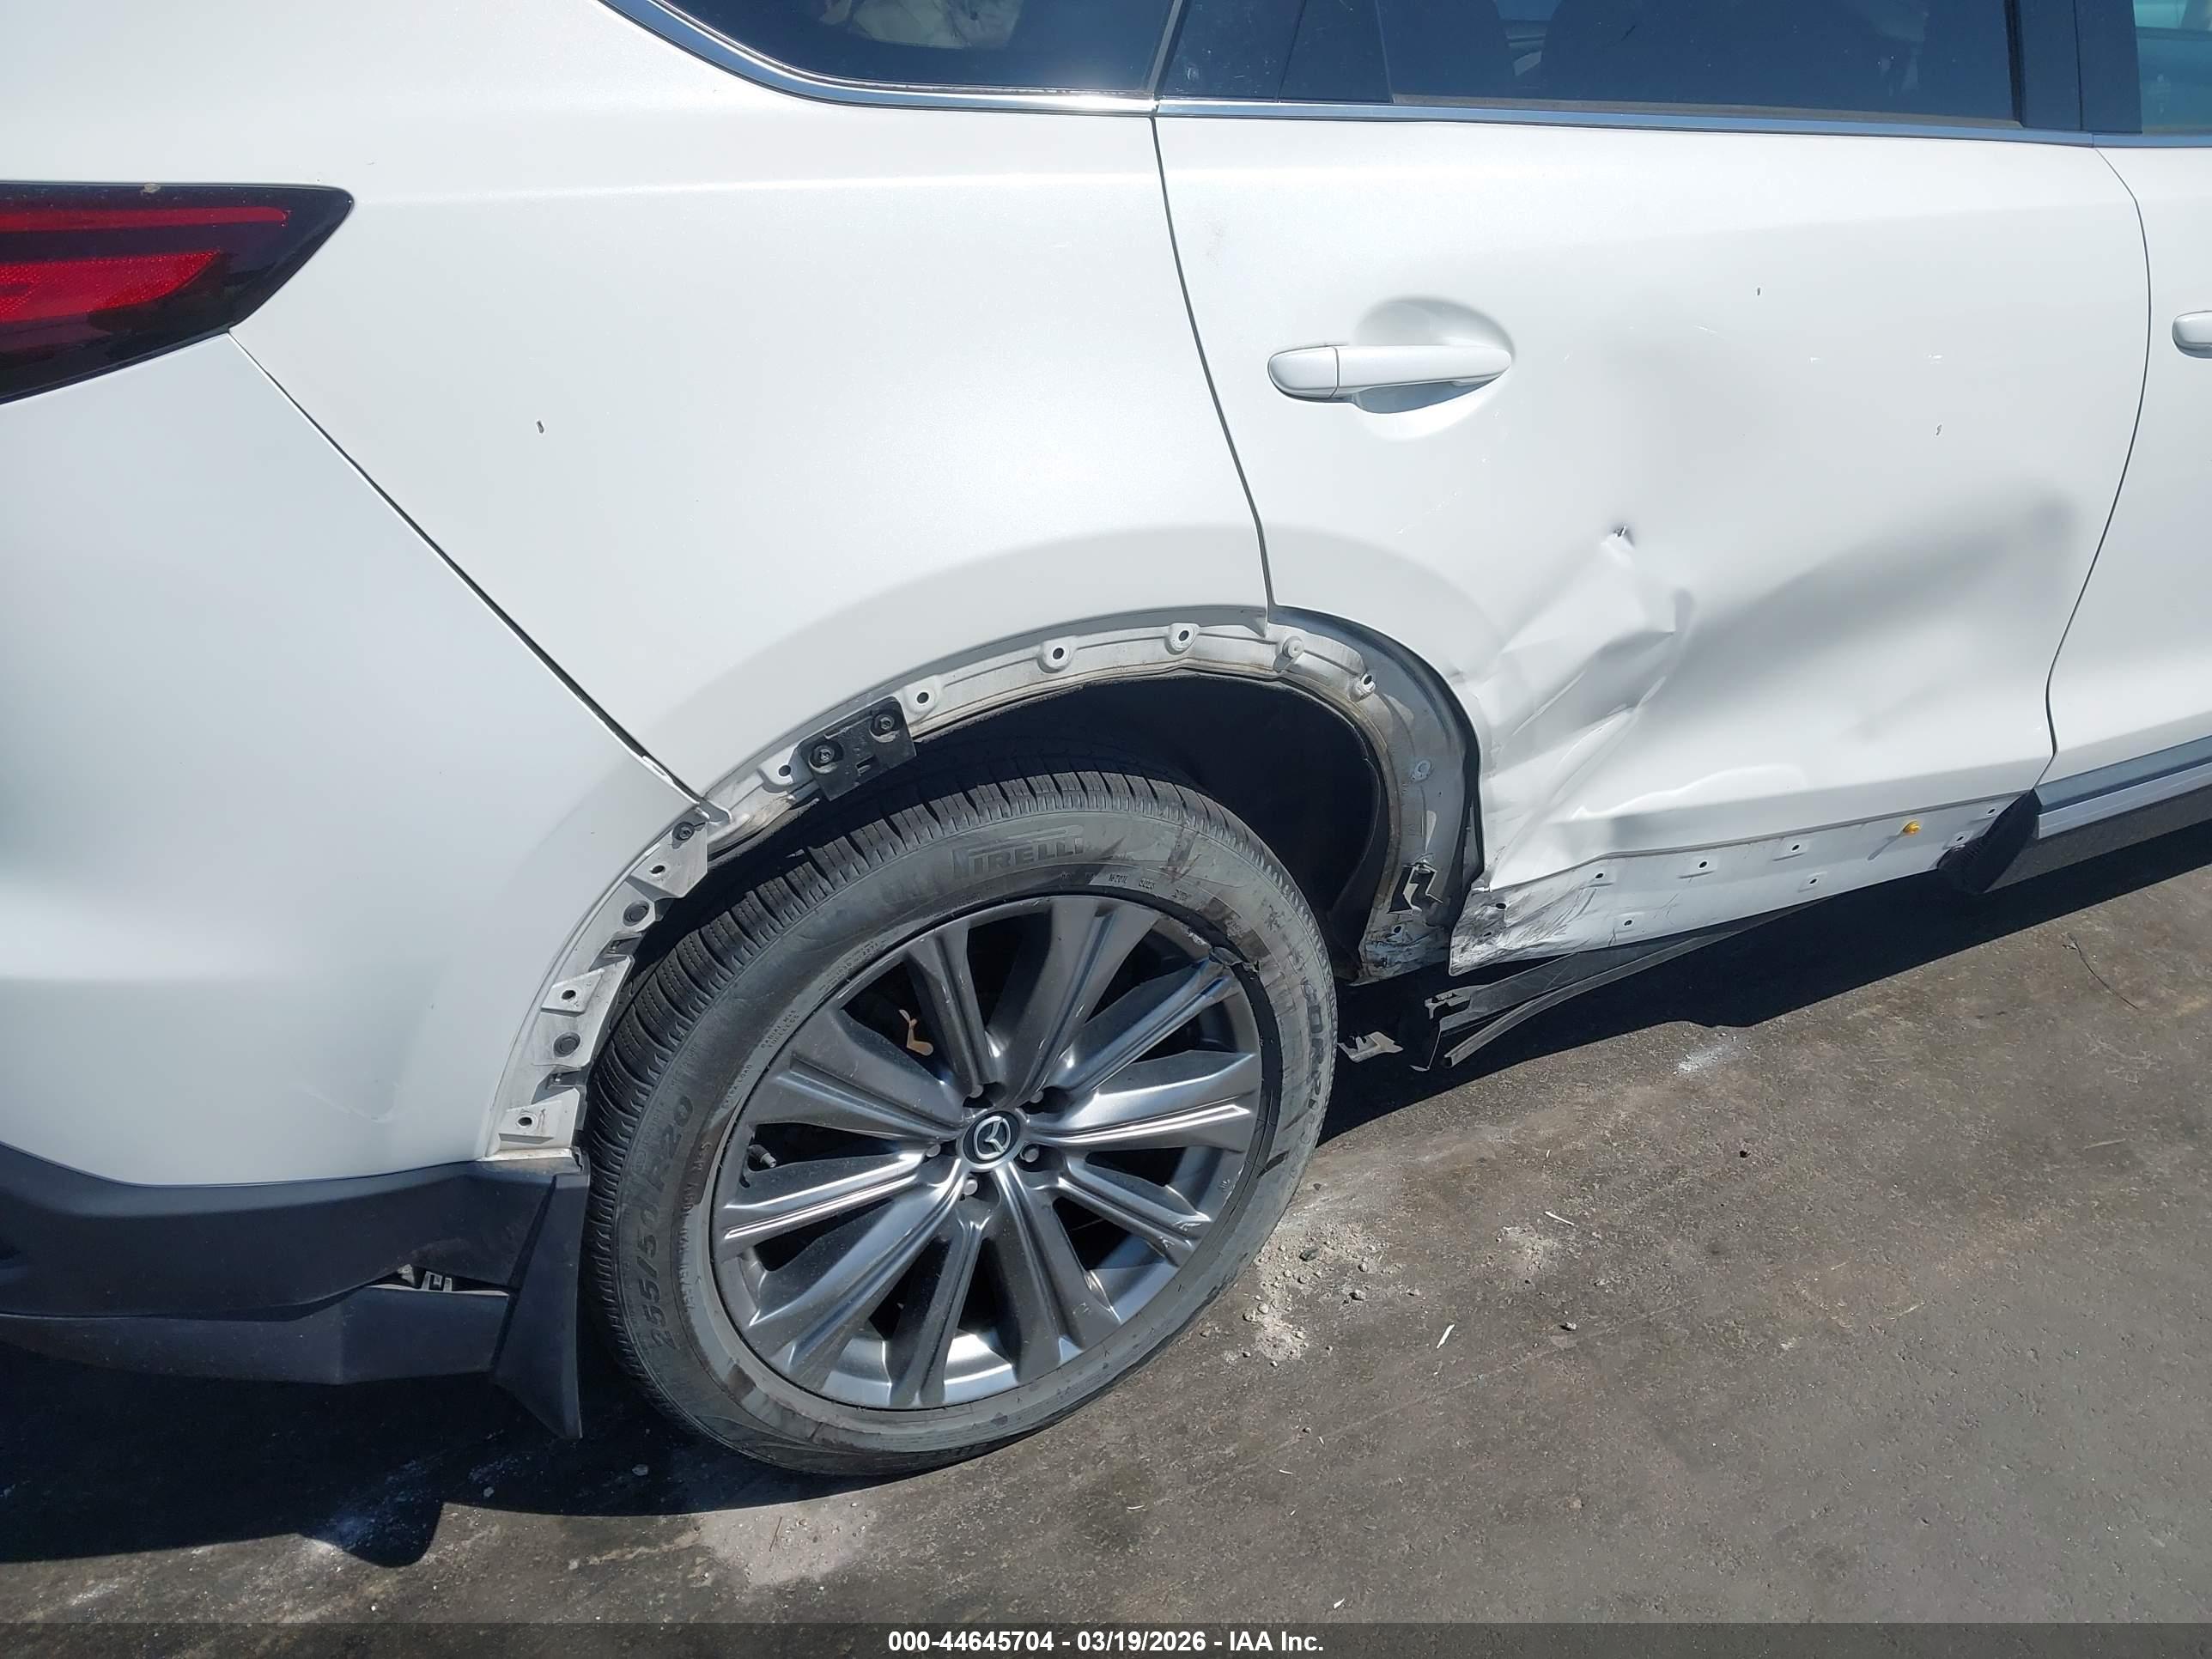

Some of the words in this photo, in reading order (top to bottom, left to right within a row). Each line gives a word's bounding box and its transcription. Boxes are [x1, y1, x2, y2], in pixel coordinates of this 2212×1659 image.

[951, 824, 1085, 879] PIRELLI
[646, 1095, 694, 1194] R20
[637, 1205, 681, 1351] 255/50
